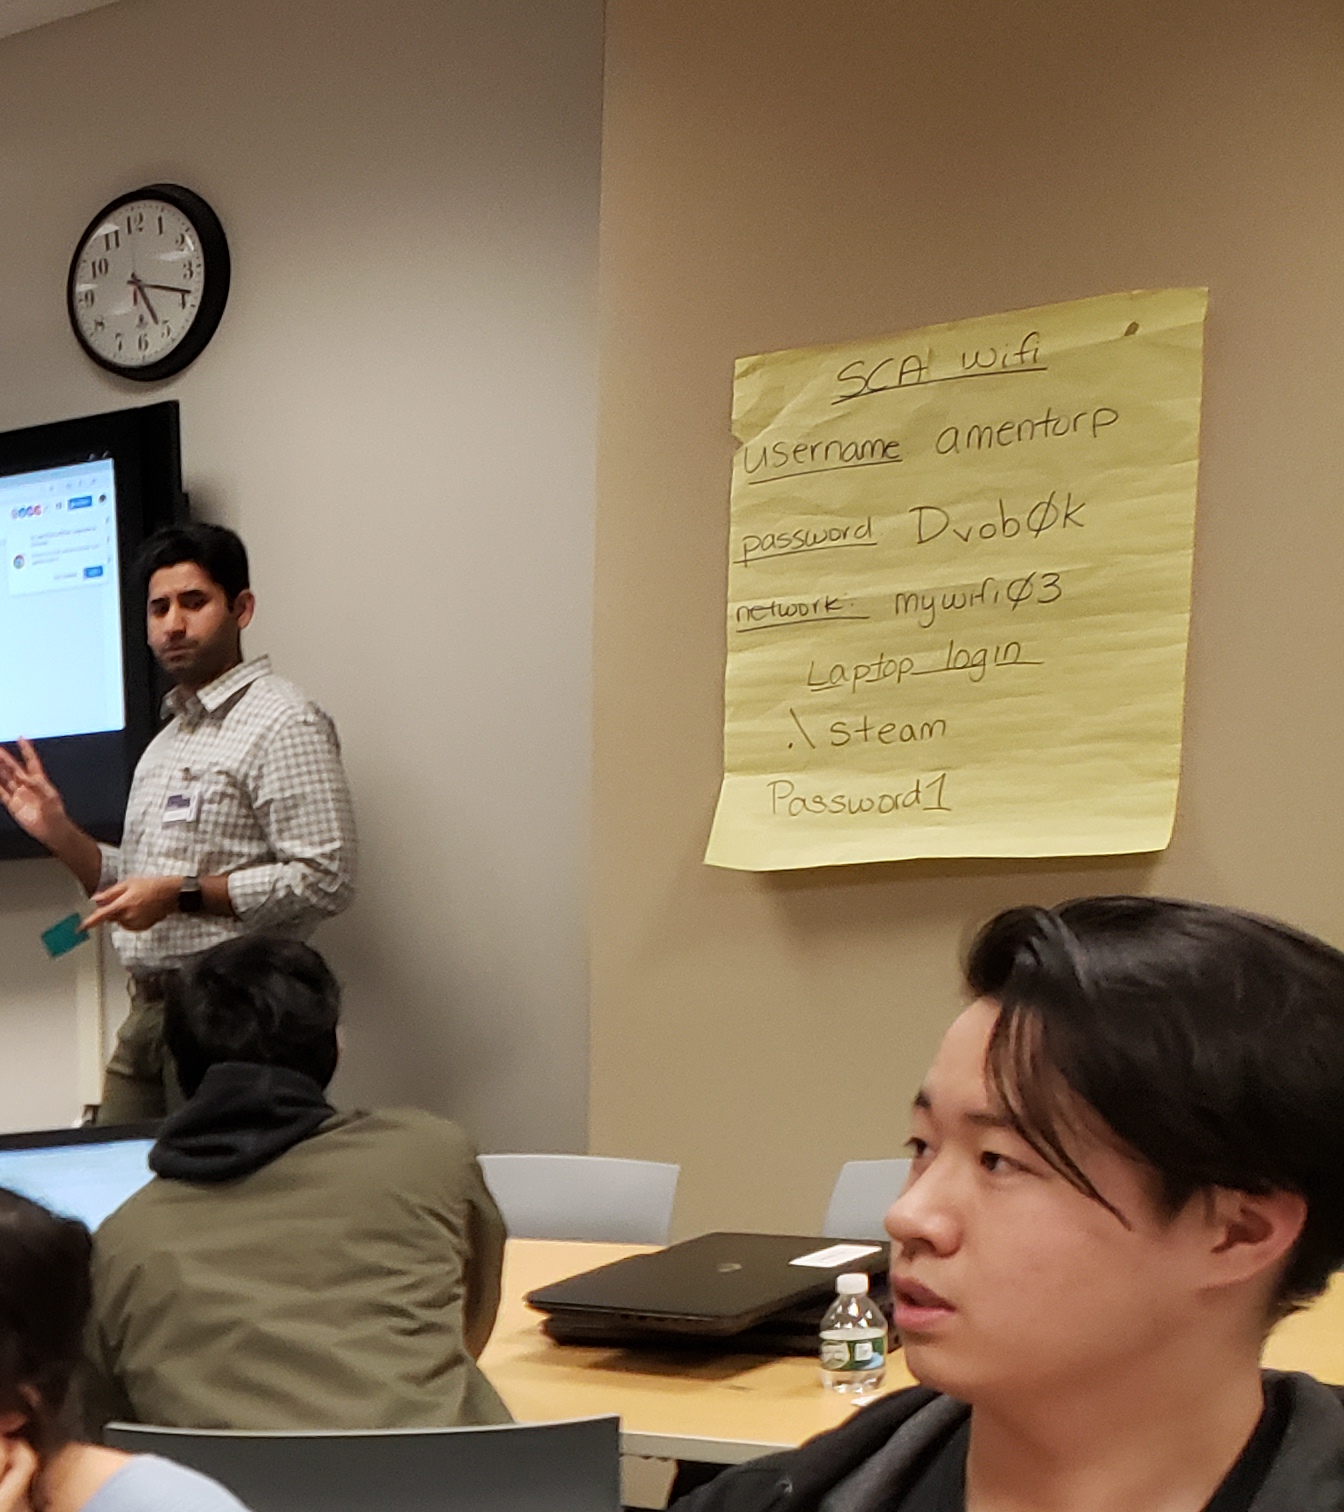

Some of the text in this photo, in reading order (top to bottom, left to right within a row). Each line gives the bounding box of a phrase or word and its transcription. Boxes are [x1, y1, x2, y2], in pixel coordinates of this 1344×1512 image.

[127, 212, 143, 235] 12
[157, 215, 164, 235] 1
[105, 230, 120, 251] 11
[175, 233, 186, 252] 2
[91, 258, 109, 279] 10
[182, 260, 194, 280] 3
[84, 290, 95, 309] 9
[160, 319, 171, 339] 5
[114, 332, 123, 352] 7
[138, 332, 149, 352] 6
[837, 354, 928, 398] SCA
[744, 407, 1119, 474] username amentorp
[742, 516, 872, 568] password
[807, 639, 1022, 693] Laptop login
[766, 772, 952, 817] Password1
